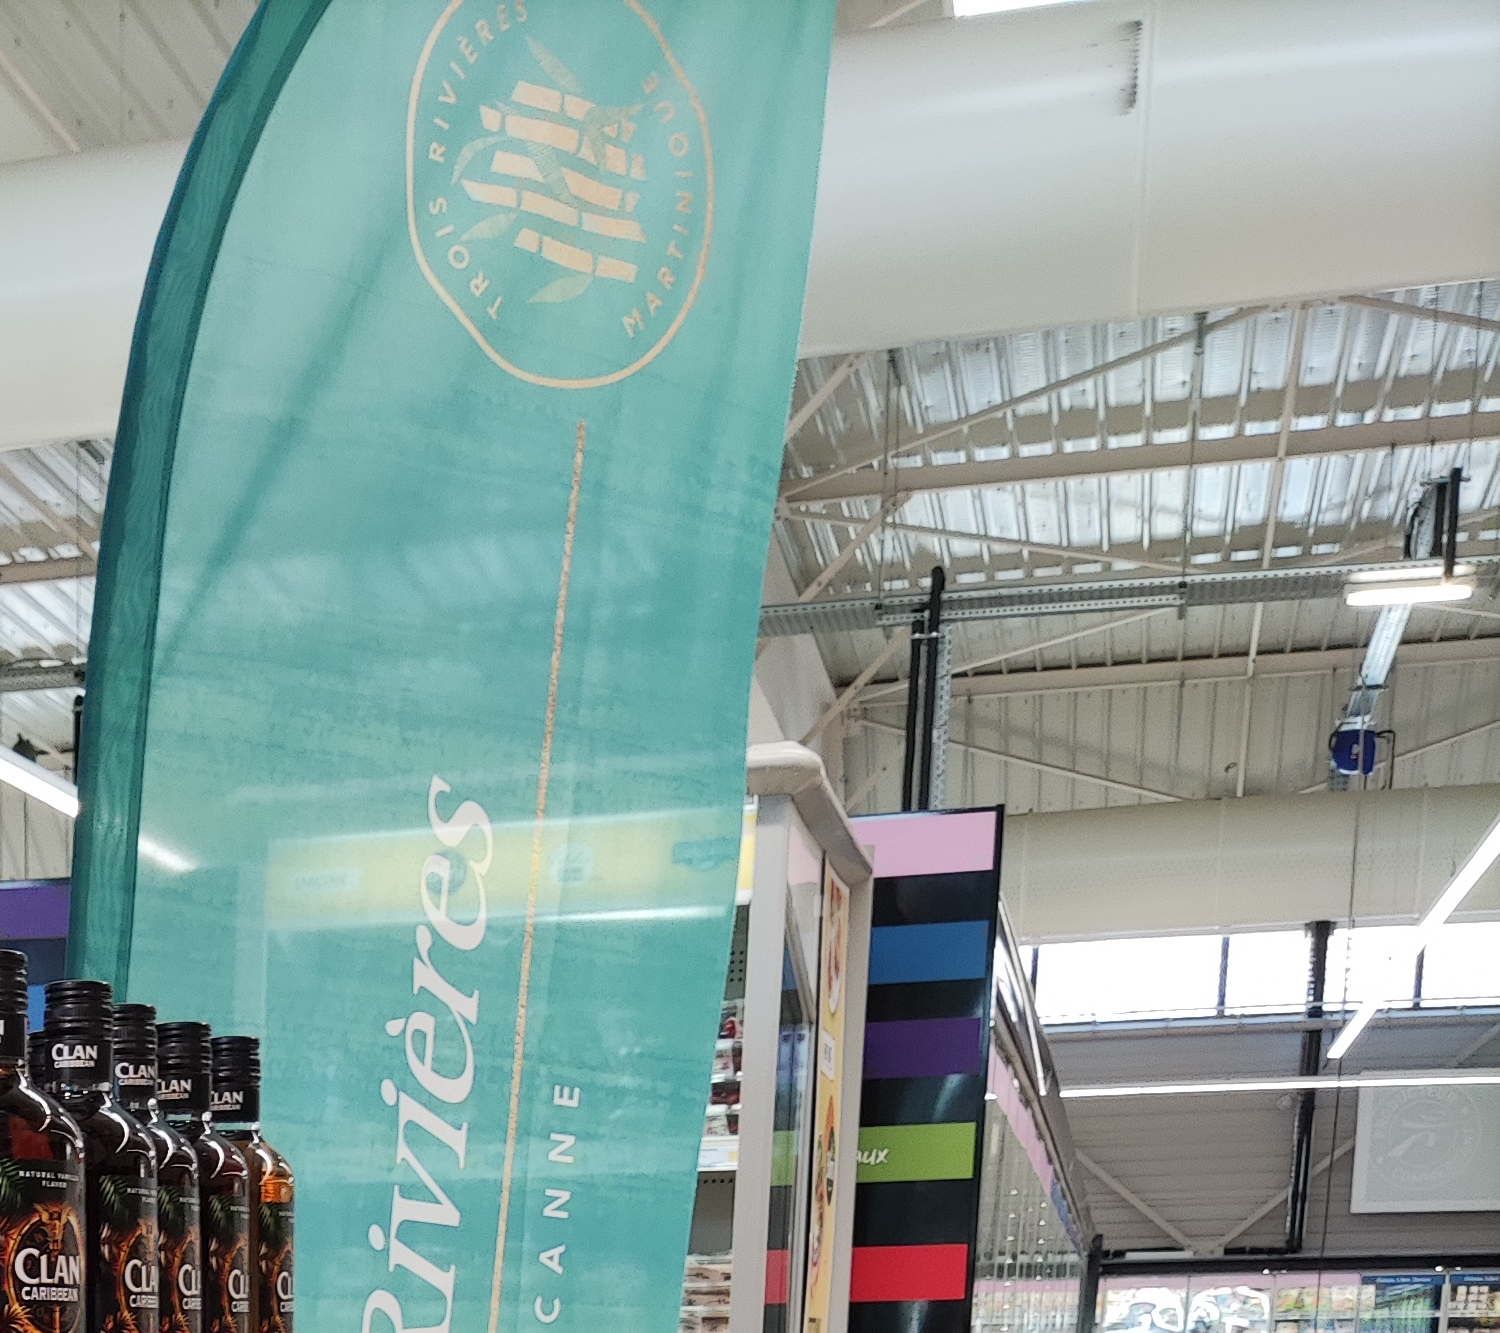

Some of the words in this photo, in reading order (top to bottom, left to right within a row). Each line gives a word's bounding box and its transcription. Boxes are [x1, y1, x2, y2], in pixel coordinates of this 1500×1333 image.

[429, 196, 503, 320] TROIS
[51, 1042, 98, 1061] CLAN
[534, 1083, 581, 1325] CANNE
[14, 1247, 81, 1286] CLAN
[124, 1258, 158, 1294] CLA
[21, 1286, 79, 1302] CARIBBEAN
